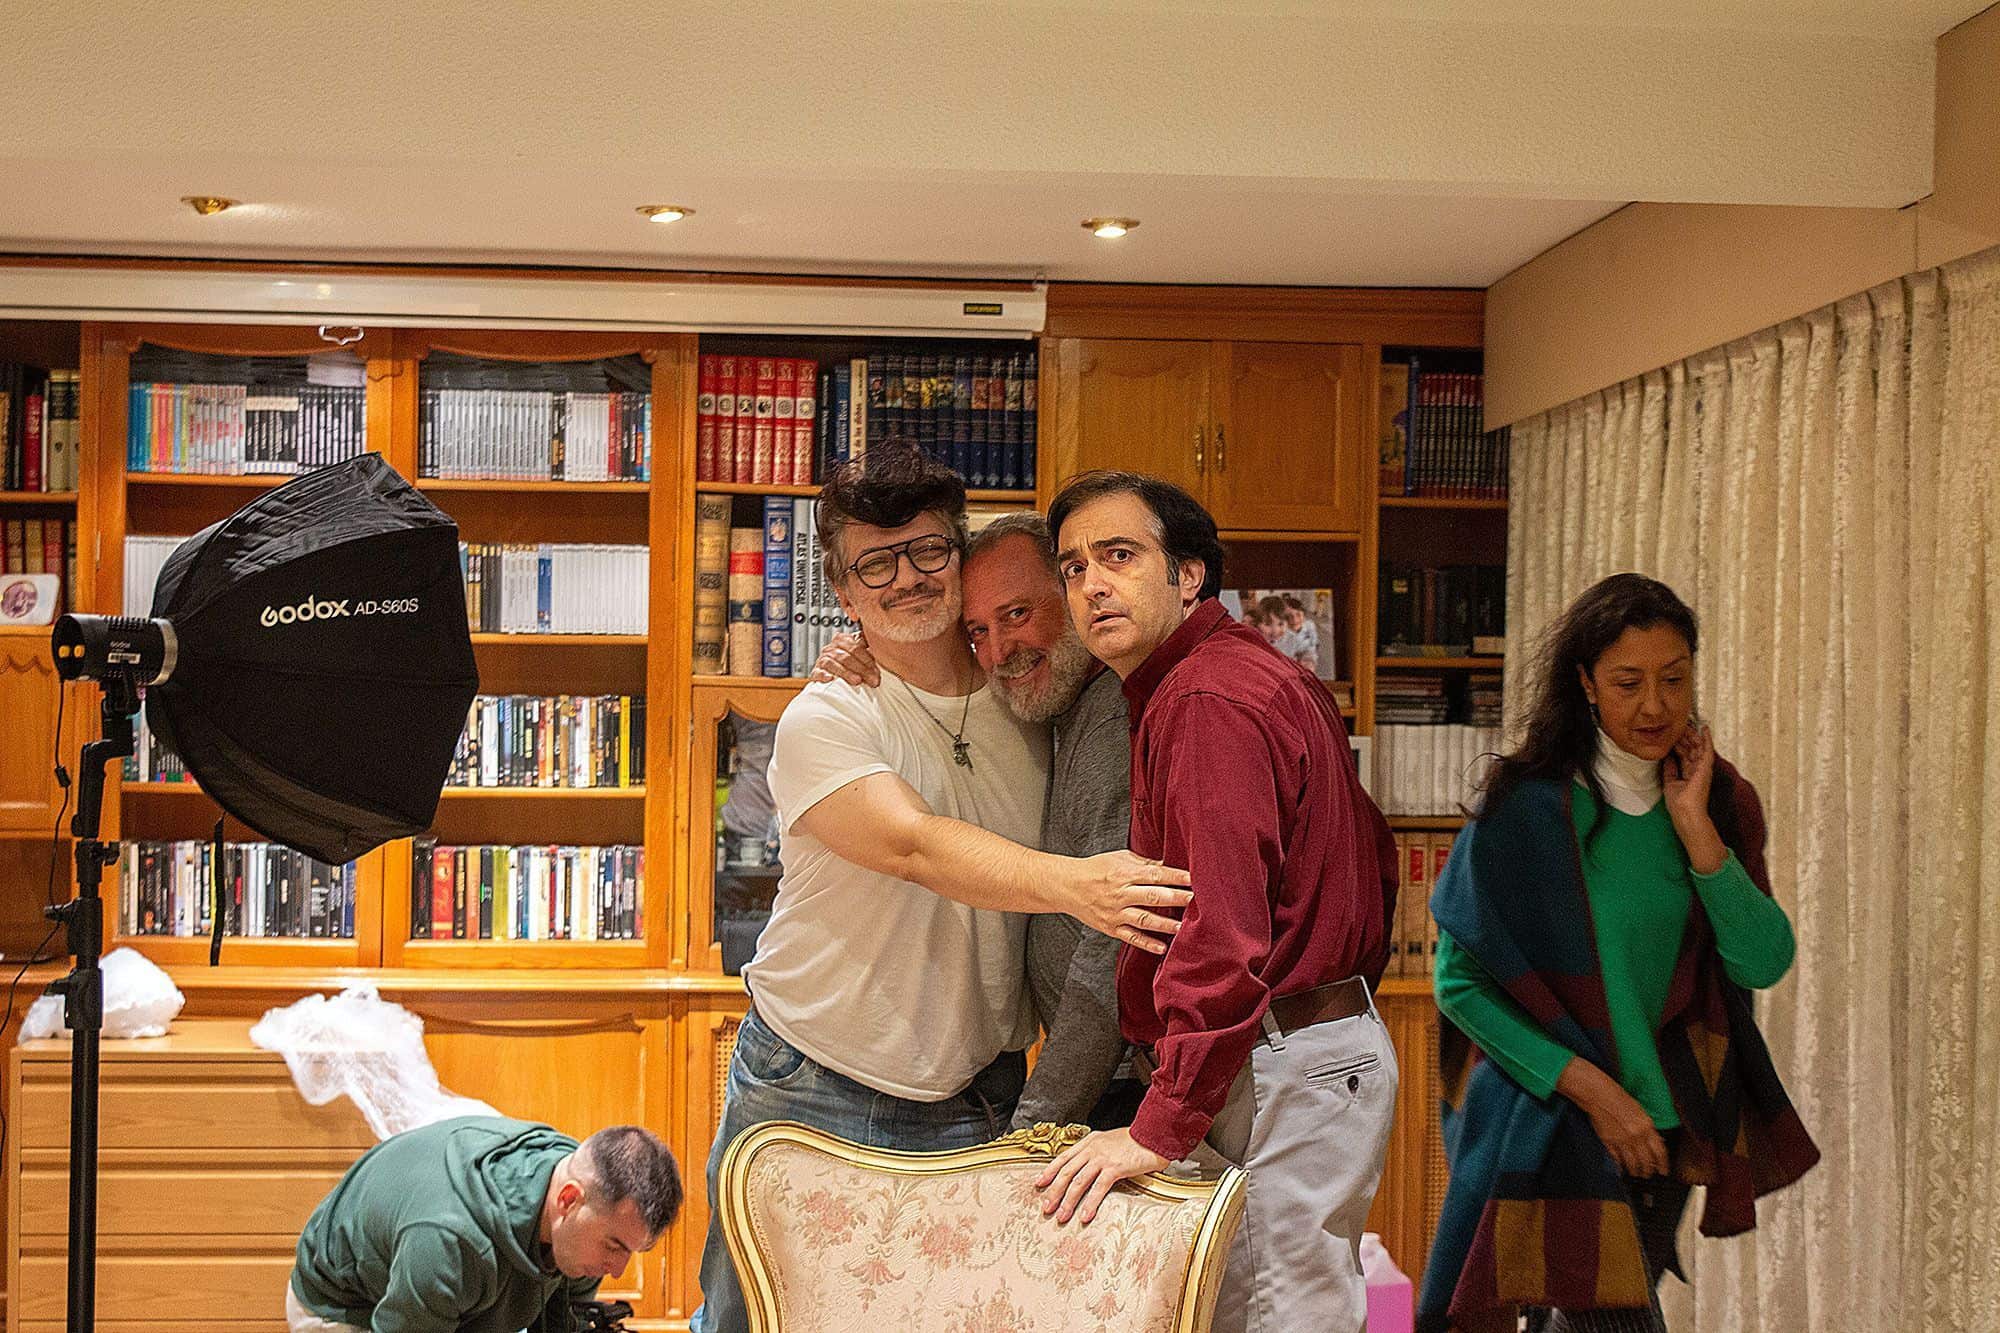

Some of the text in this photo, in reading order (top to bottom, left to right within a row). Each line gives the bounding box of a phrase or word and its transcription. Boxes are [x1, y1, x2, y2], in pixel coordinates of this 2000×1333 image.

[796, 532, 808, 605] ATLAS UNIVERSAL
[811, 561, 822, 607] UNIVERSAL
[260, 594, 419, 627] Godox AD-S60S
